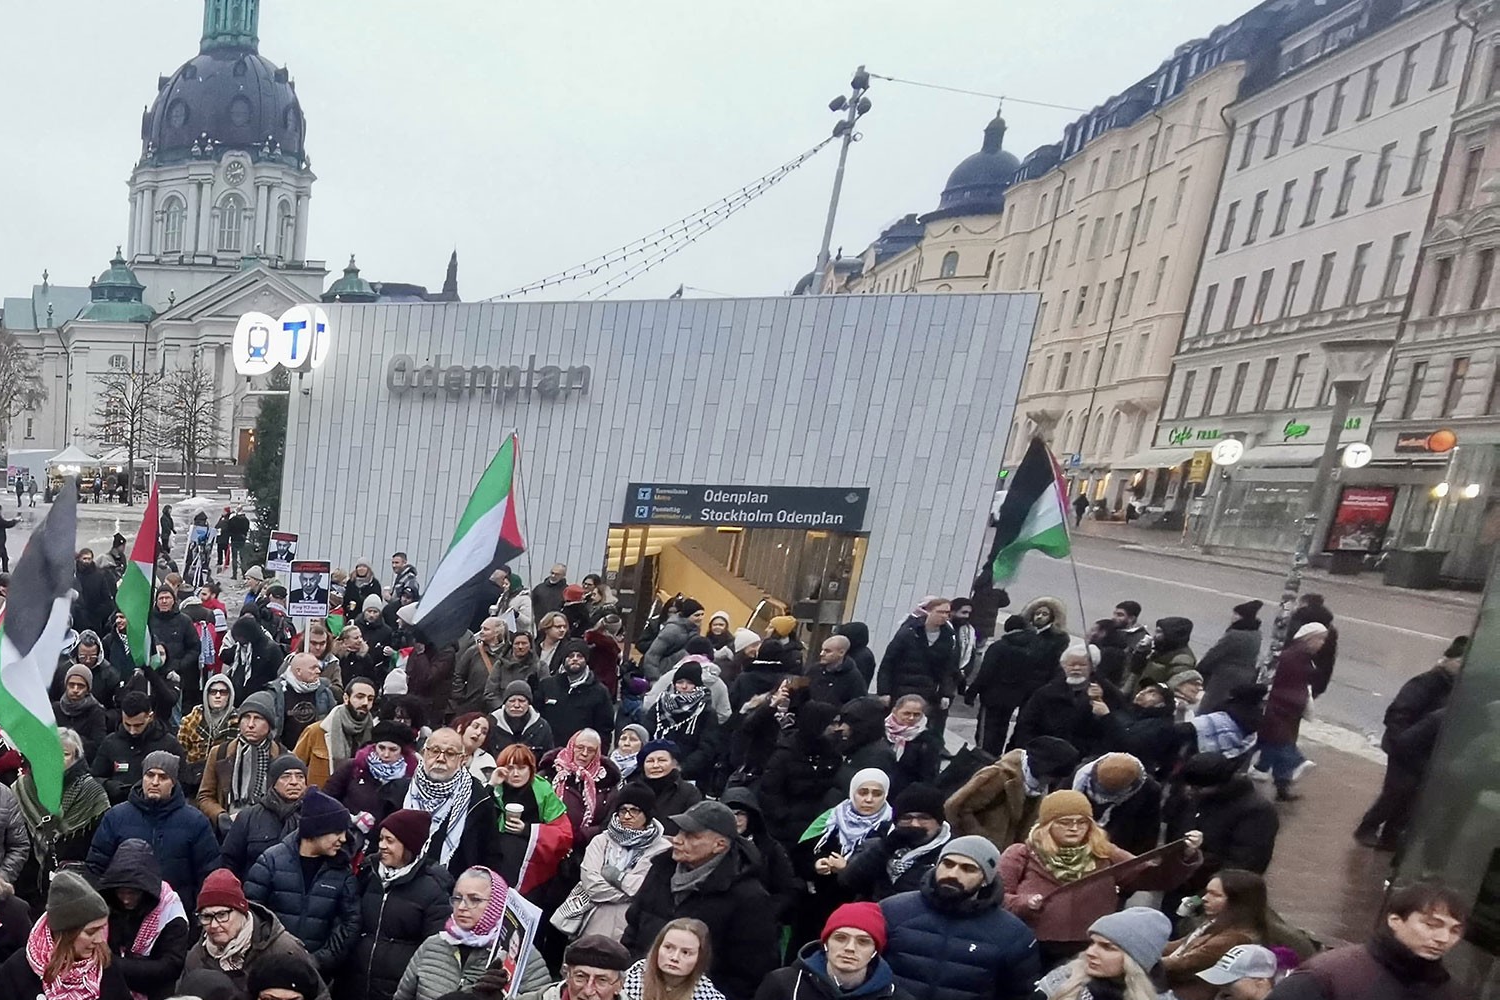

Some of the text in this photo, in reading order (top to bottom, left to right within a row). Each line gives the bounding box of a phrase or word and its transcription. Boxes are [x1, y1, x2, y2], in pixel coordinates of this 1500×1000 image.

[283, 320, 307, 360] T
[385, 353, 592, 406] Odenplan
[704, 488, 768, 504] Odenplan
[700, 507, 843, 525] Stockholm Odenplan
